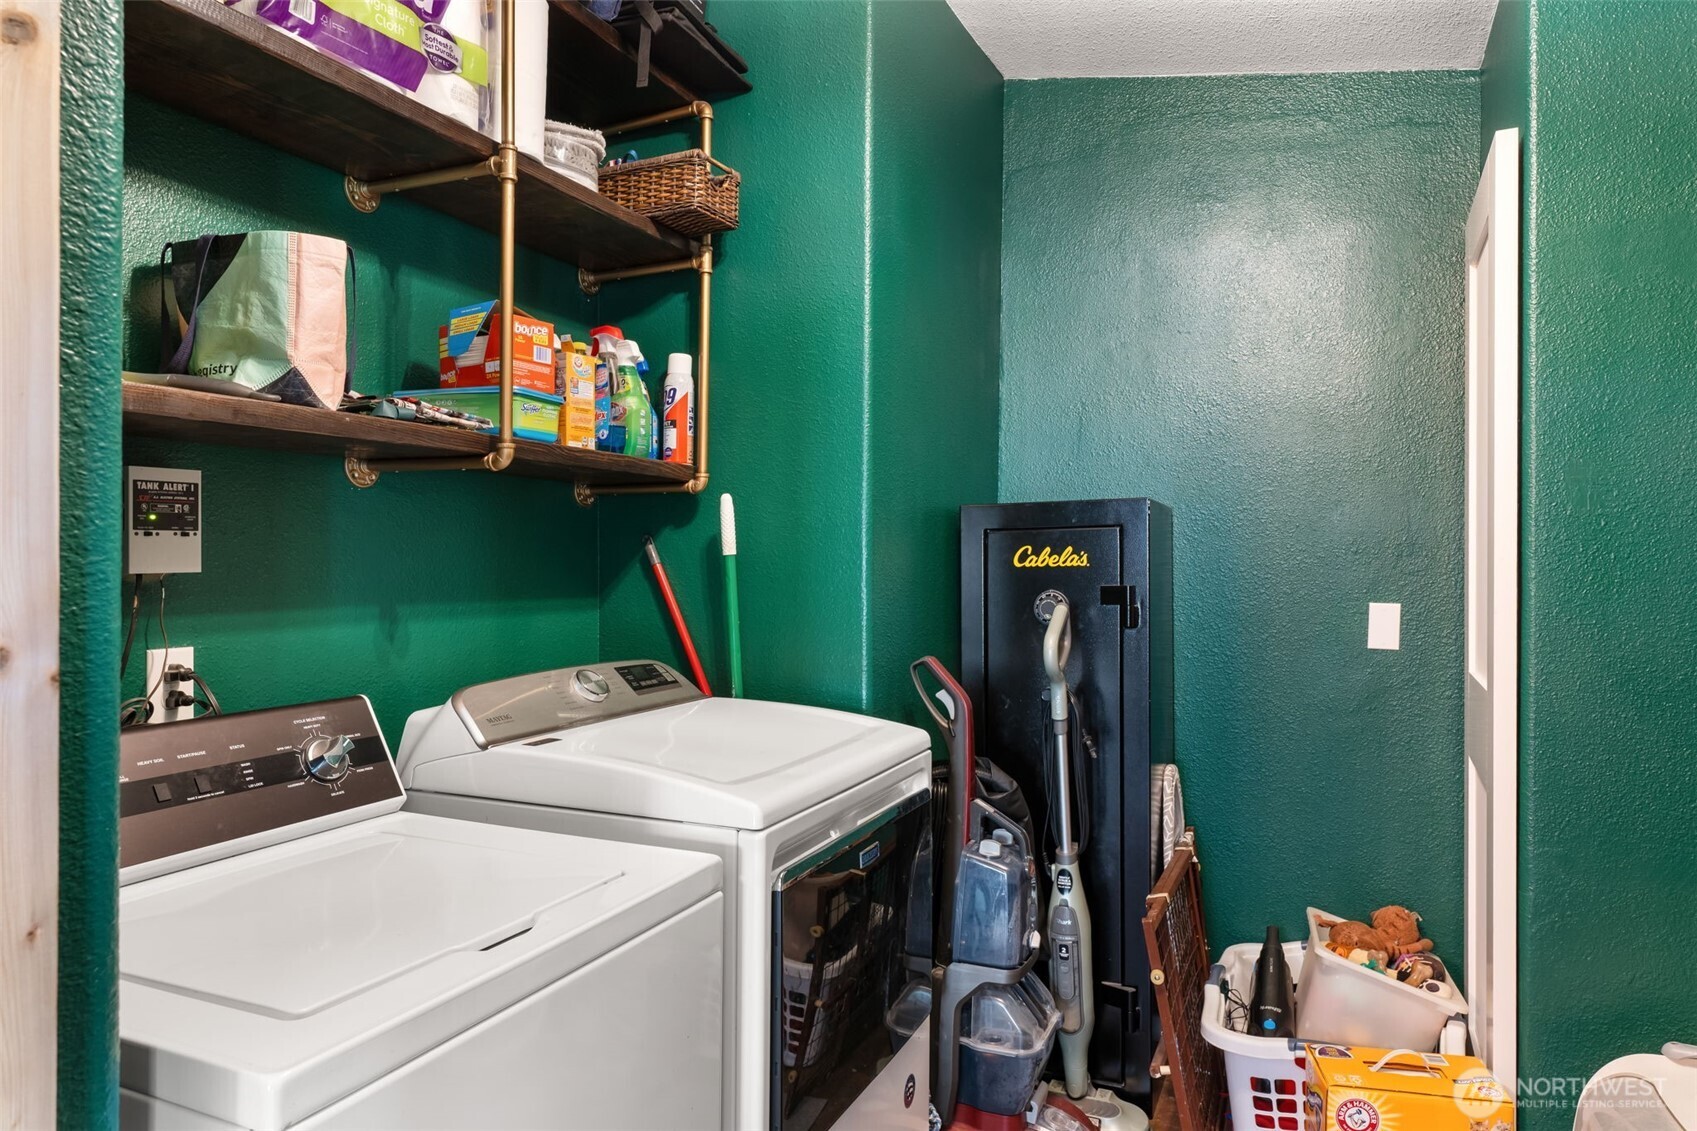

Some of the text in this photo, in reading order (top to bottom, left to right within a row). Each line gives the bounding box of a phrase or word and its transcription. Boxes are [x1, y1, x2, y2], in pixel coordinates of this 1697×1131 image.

[374, 13, 405, 37] Cloth
[424, 33, 449, 50] Softest
[428, 54, 451, 68] TOWEL
[434, 45, 459, 63] Durable
[514, 321, 548, 337] bounce
[196, 363, 238, 378] egistry
[137, 481, 159, 490] TANK
[163, 482, 187, 491] ALERT
[1013, 545, 1088, 568] Cabela's
[305, 715, 326, 723] SELECTION
[485, 713, 513, 724] MAYTAG
[229, 743, 245, 751] STATUS
[176, 750, 206, 760] START/PAUSE
[136, 759, 153, 767] HEAVY
[1338, 1106, 1348, 1121] ARM
[1353, 1101, 1377, 1124] HAMMER
